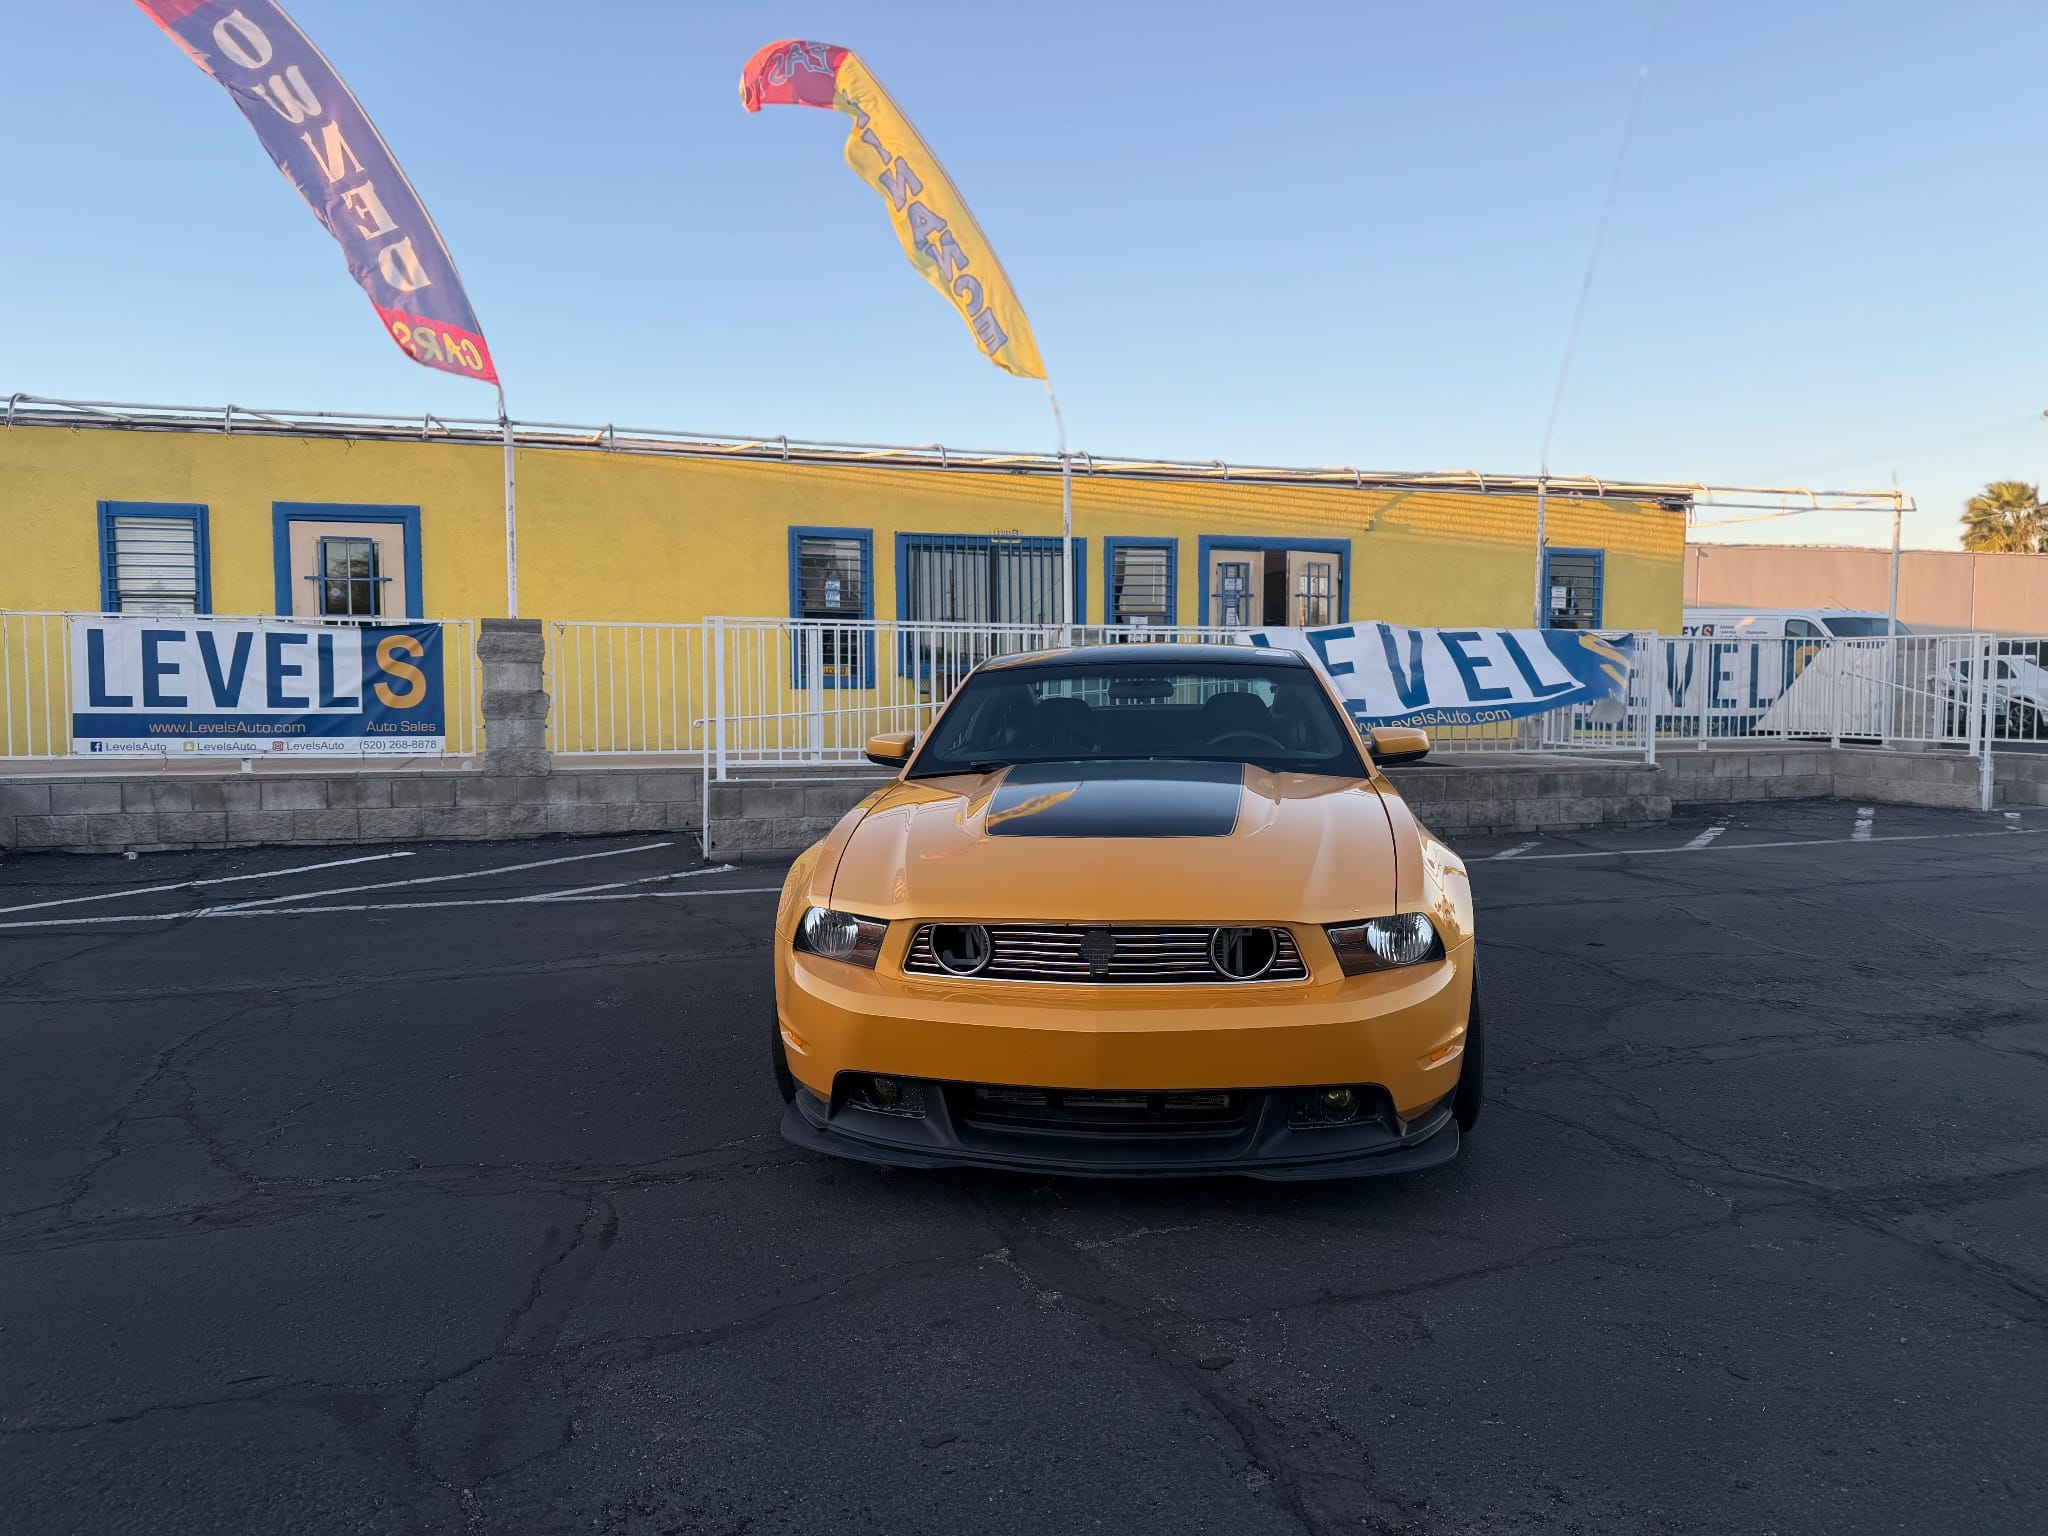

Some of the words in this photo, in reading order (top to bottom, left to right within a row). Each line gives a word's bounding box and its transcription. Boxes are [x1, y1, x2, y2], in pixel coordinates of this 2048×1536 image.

[86, 628, 427, 710] LEVELS
[1249, 623, 1631, 716] EVELS
[366, 720, 397, 733] Auto
[400, 720, 437, 733] Sales
[1355, 708, 1512, 732] wwLevelsAuto.com
[149, 720, 306, 734] www.LevelsAuto.com
[106, 742, 167, 752] LevelsAuto
[197, 742, 257, 752] LevelsAuto
[286, 741, 345, 751] LevelsAuto
[359, 740, 386, 751] (520)
[389, 740, 437, 749] 268-8878
